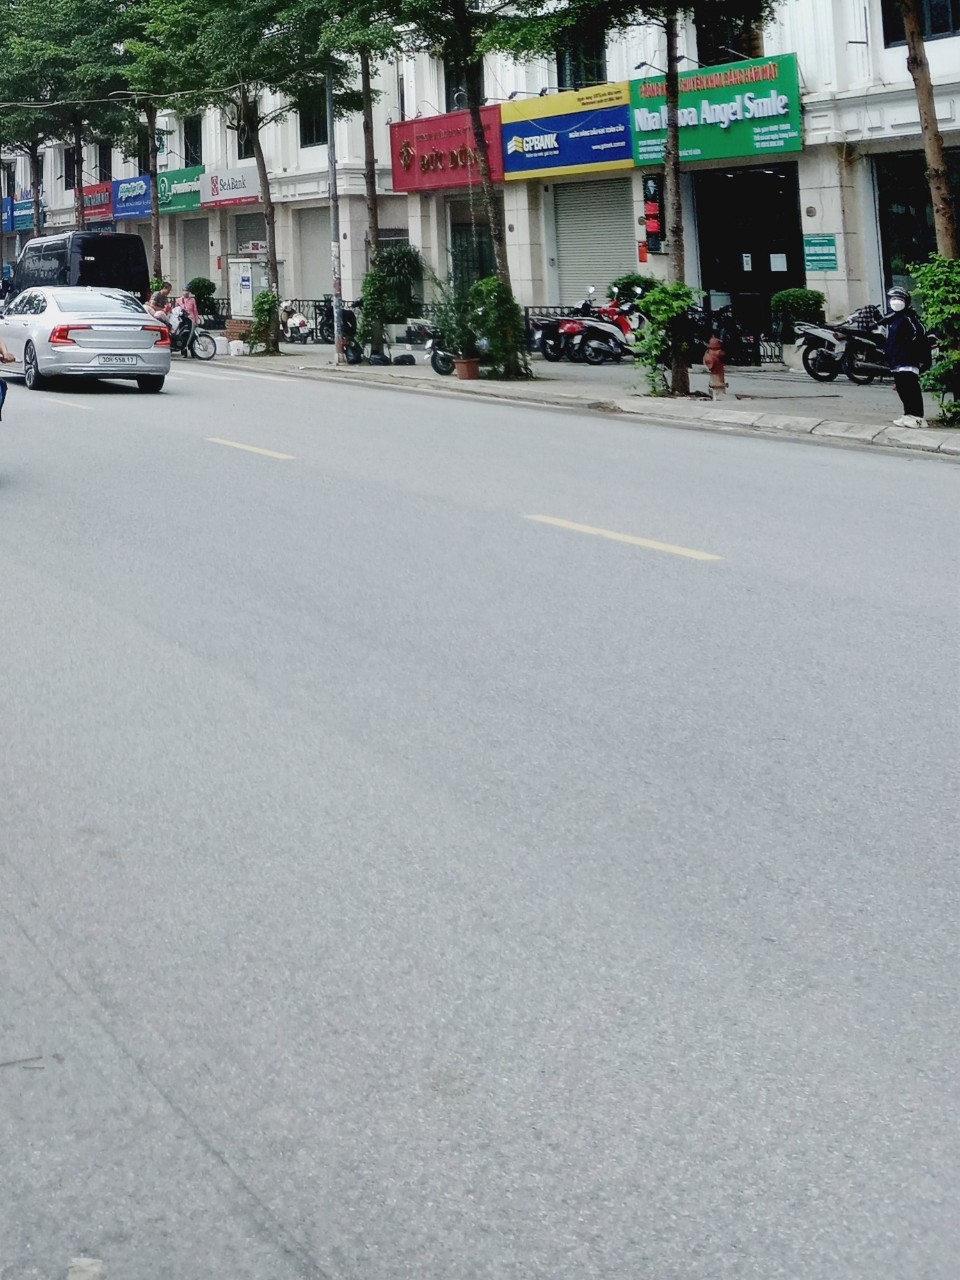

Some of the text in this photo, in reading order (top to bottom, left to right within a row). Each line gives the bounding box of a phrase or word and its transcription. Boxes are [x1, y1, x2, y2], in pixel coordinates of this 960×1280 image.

[634, 107, 660, 132] Nha
[701, 94, 744, 129] Angel
[744, 89, 789, 119] Smile
[523, 133, 560, 152] GPBANK
[220, 175, 247, 192] SeABank
